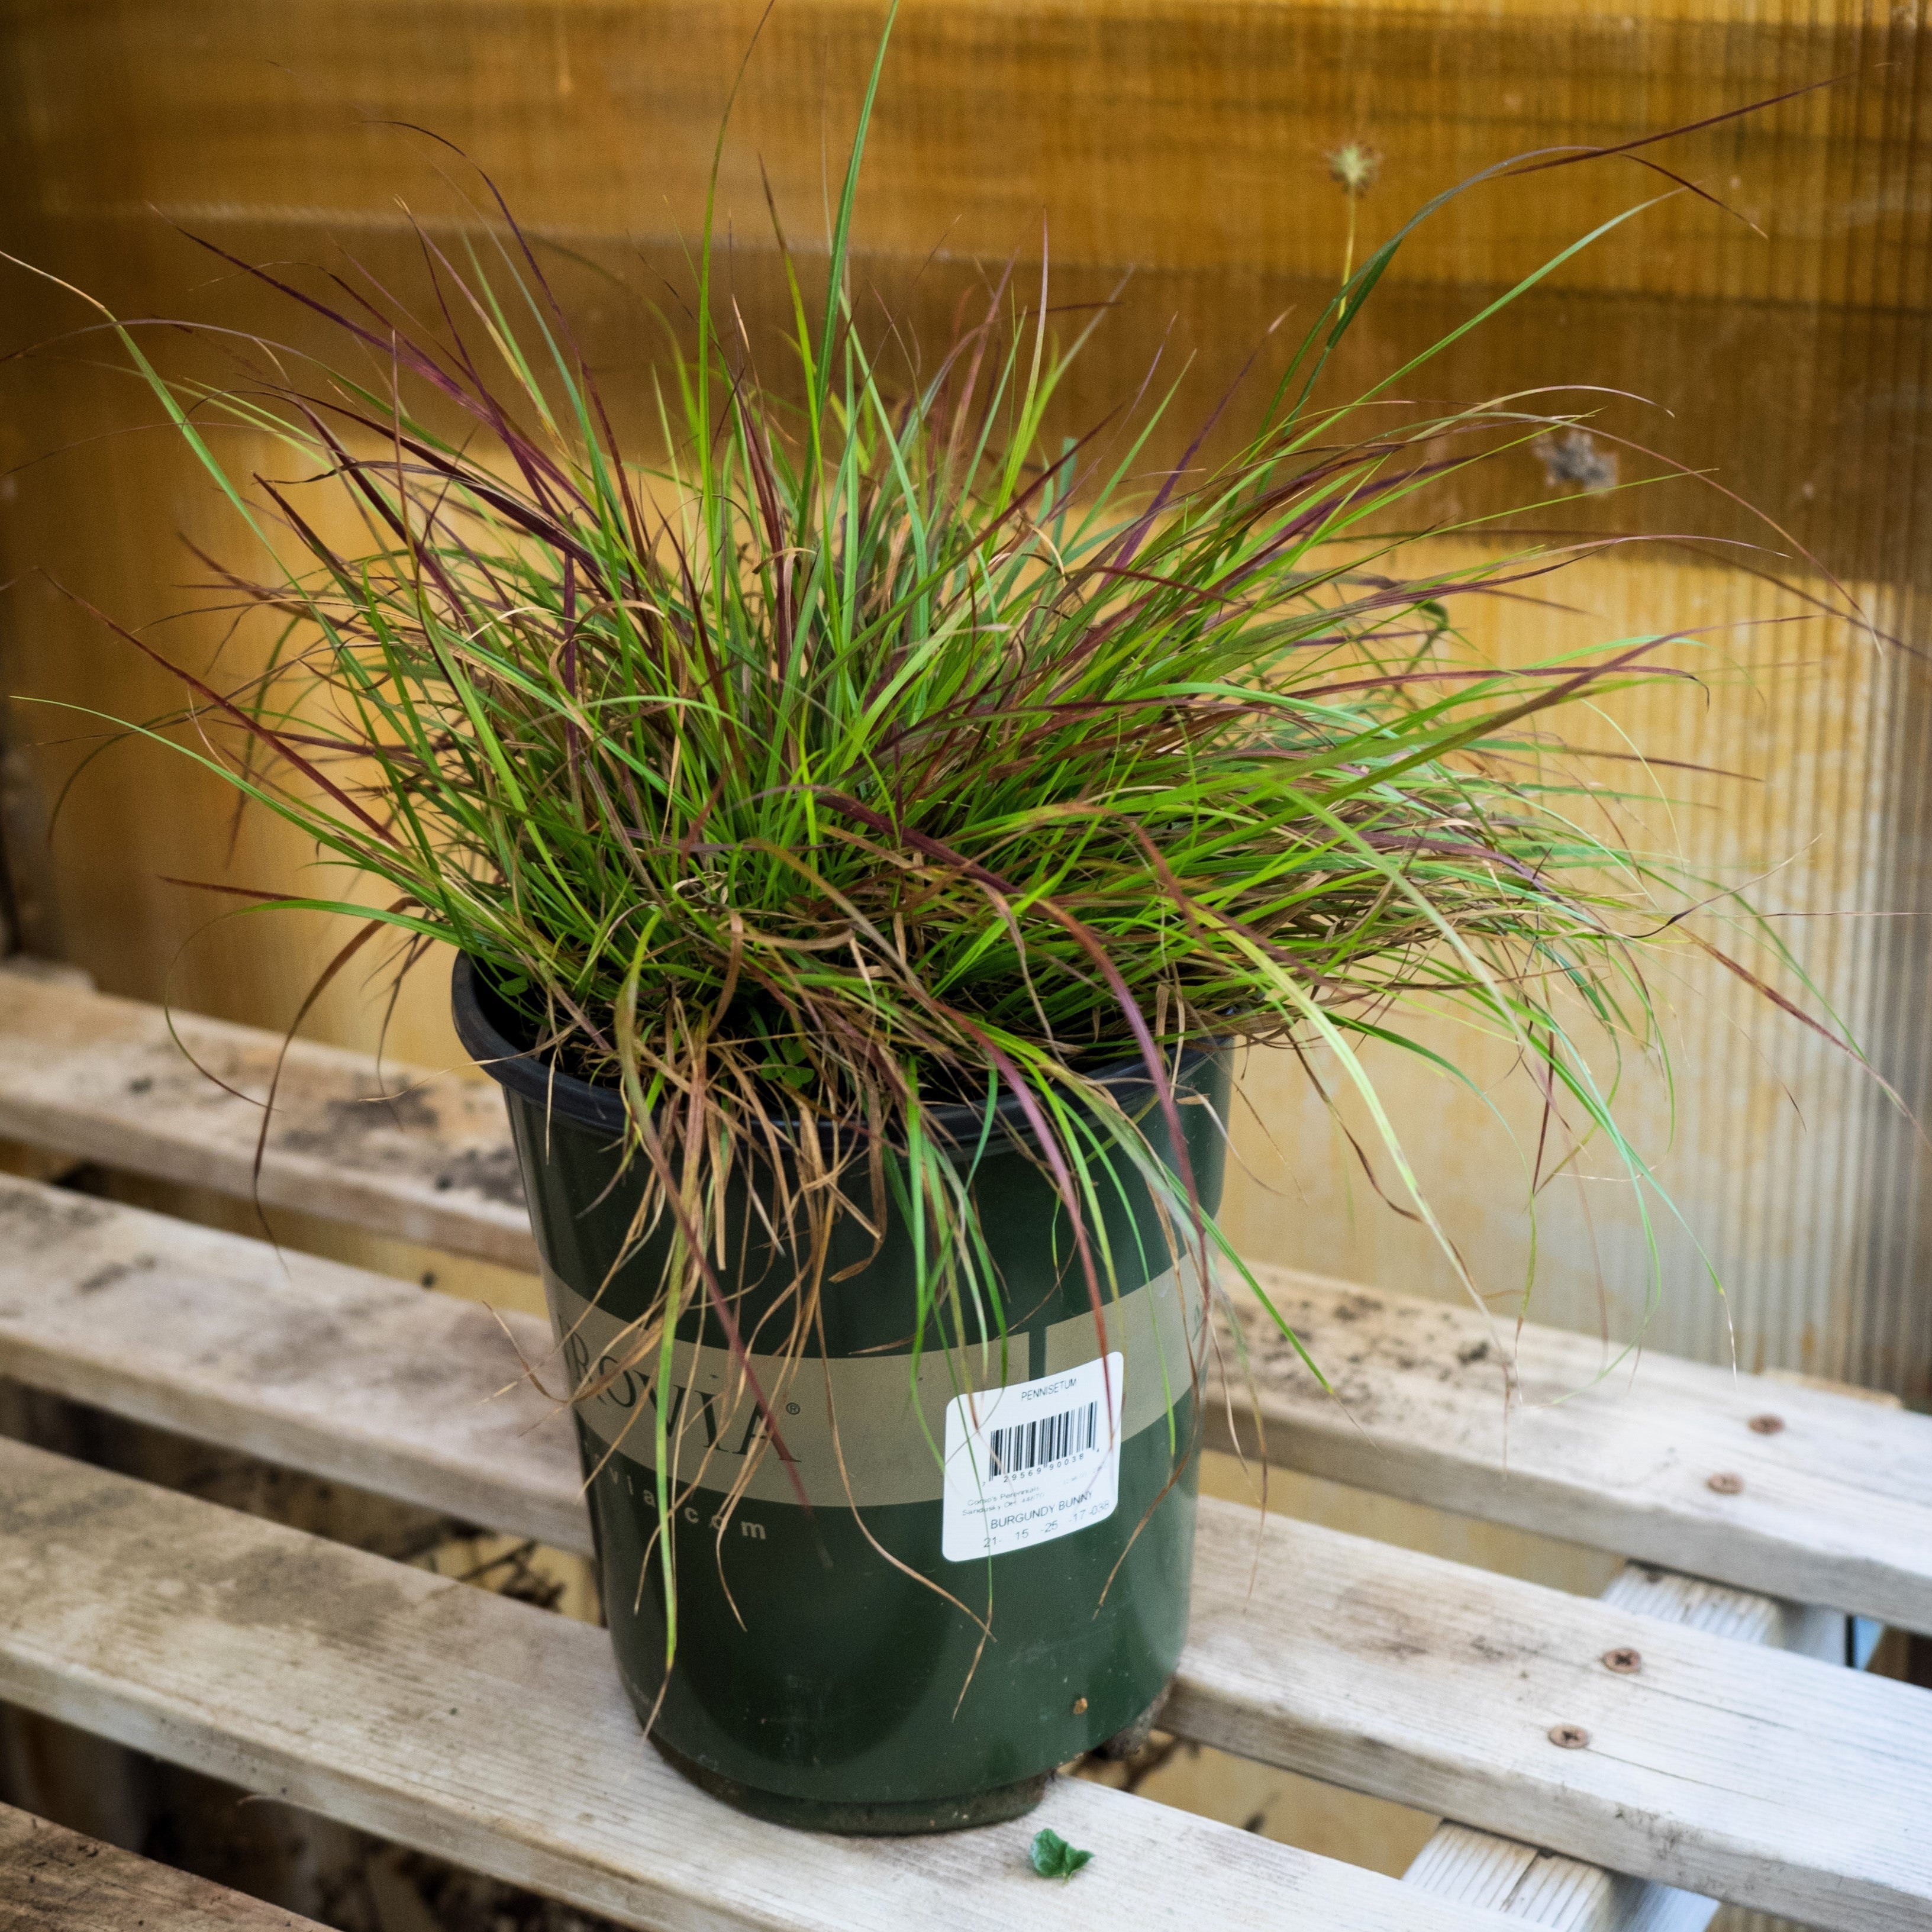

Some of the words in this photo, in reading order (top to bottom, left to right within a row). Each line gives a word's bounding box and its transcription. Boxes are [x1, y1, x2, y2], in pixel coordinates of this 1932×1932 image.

[559, 1315, 802, 1463] ROVIA
[1021, 1378, 1077, 1401] PENNISETUM
[1003, 1467, 1041, 1483] 29569
[1049, 1453, 1084, 1470] 90038
[991, 1504, 1056, 1530] BURGUNDY
[1059, 1491, 1093, 1511] BUNNY
